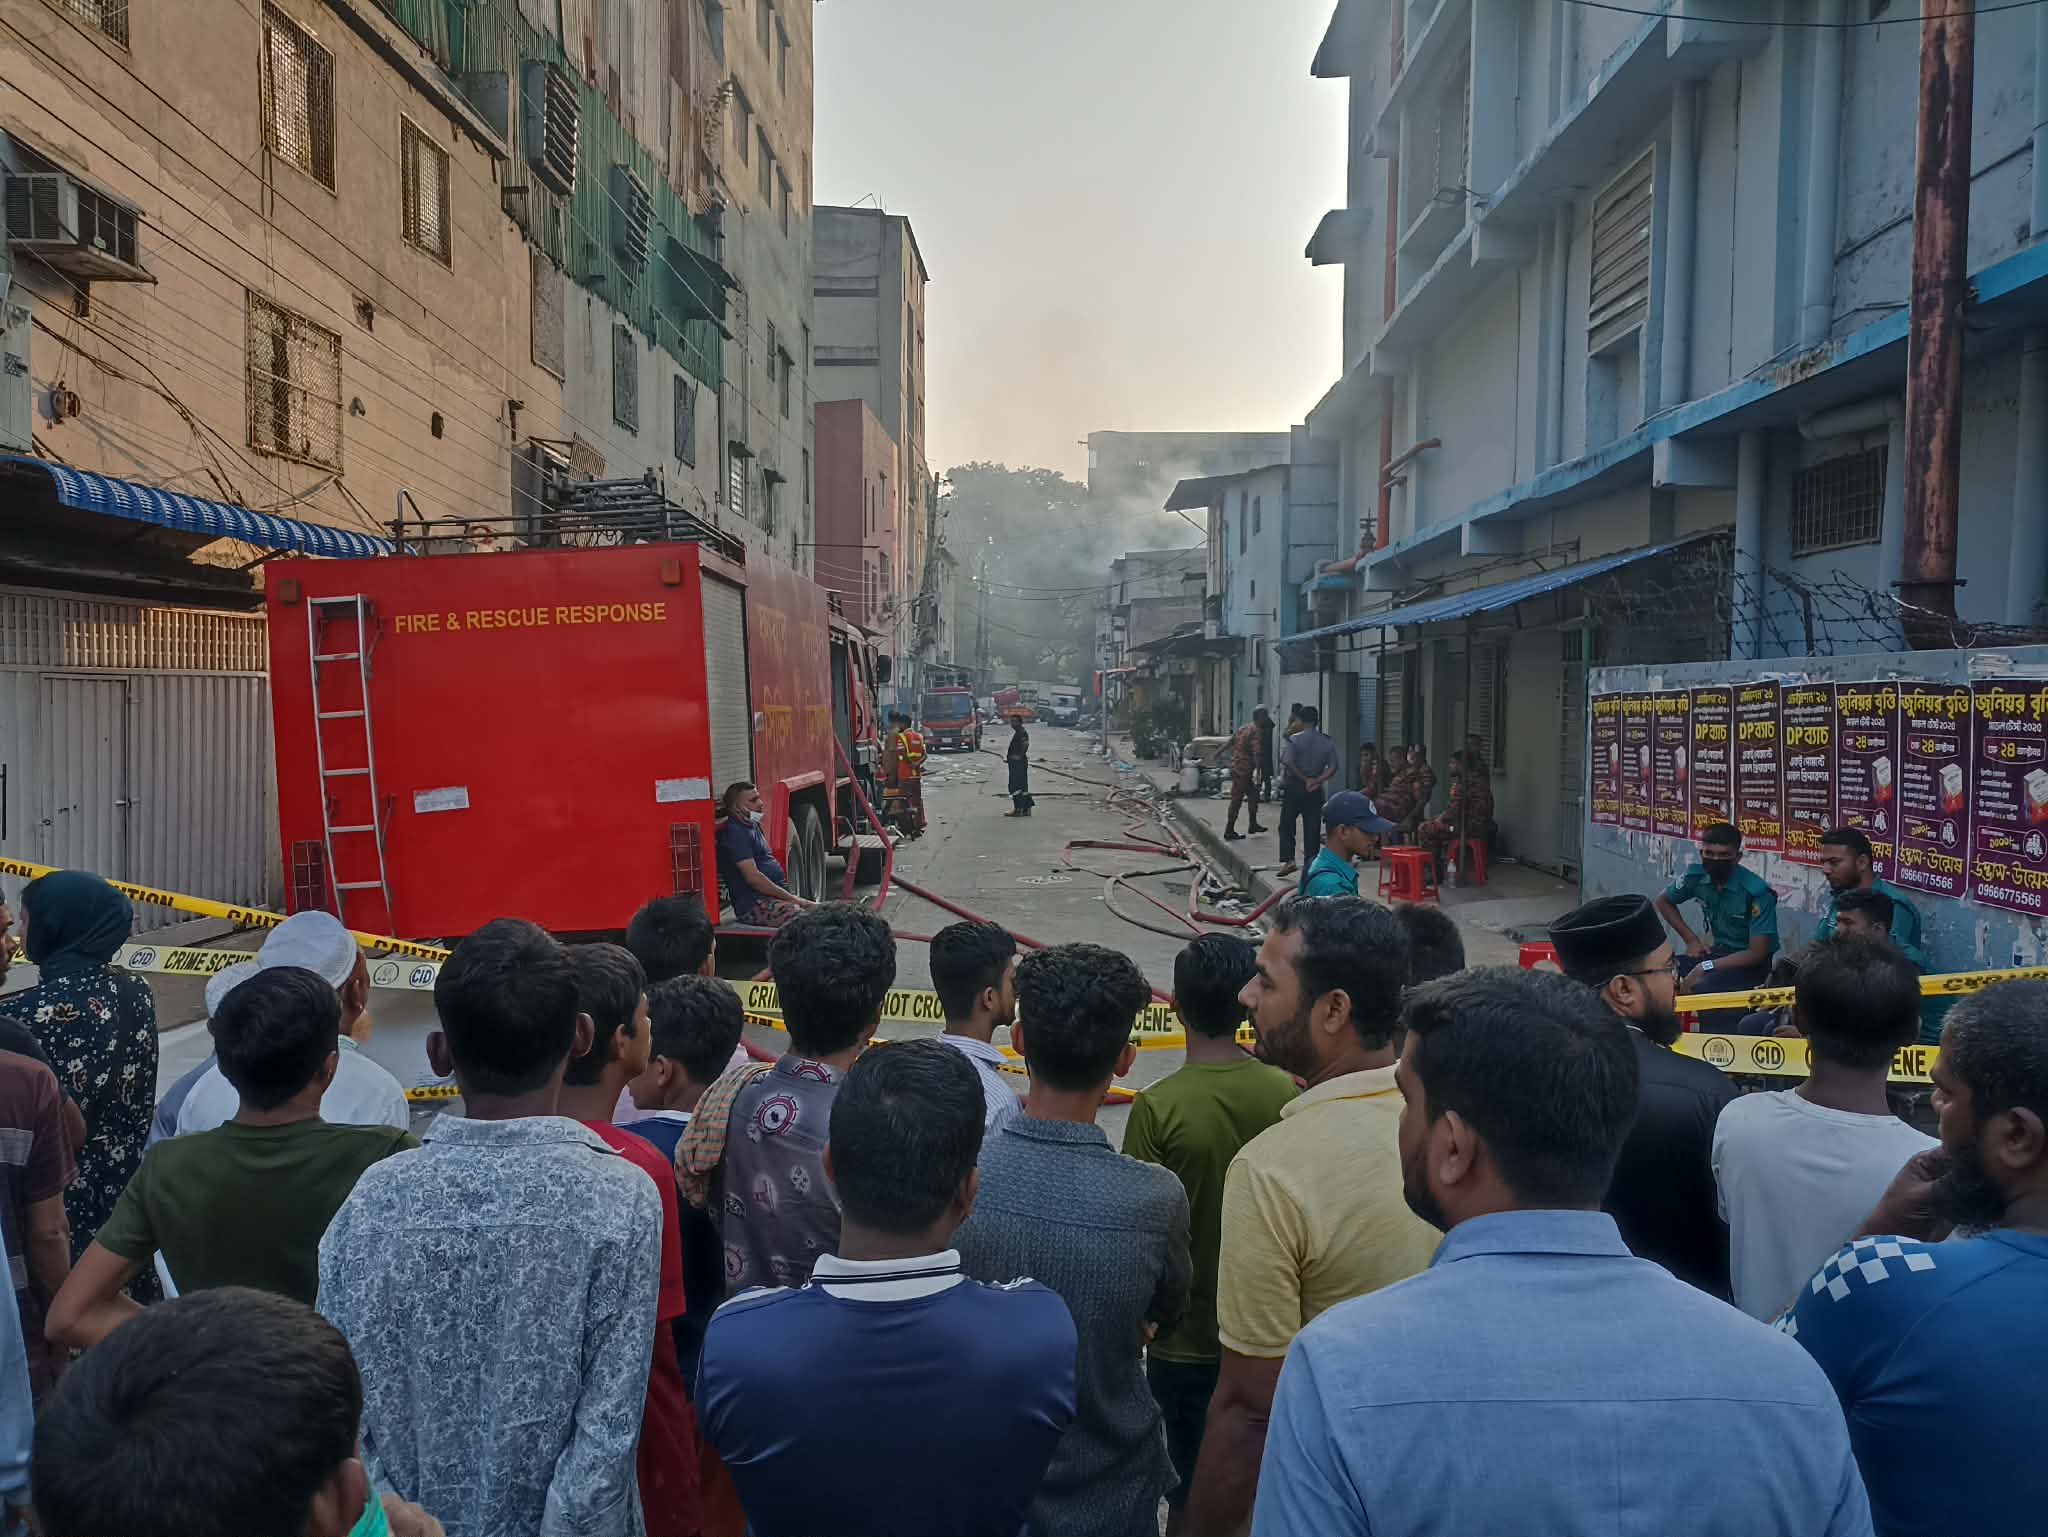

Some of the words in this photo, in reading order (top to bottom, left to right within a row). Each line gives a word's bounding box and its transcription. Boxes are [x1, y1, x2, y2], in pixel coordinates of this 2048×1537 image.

[395, 613, 441, 633] FIRE
[446, 612, 462, 631] &
[467, 607, 550, 630] RESCUE
[556, 602, 667, 626] RESPONSE
[1838, 688, 1873, 716] জুনিয়র
[1874, 688, 1896, 716] বৃত্তি
[1901, 688, 1944, 718] জুনিয়র
[1945, 689, 1969, 719] বৃত্তি
[1975, 686, 2026, 720] জুনিয়র
[1696, 723, 1708, 740] DP
[1739, 722, 1754, 740] DP
[1754, 721, 1775, 738] ব্যাচ
[1786, 727, 1803, 745] DP
[1804, 727, 1830, 745] ব্যাচ
[1855, 735, 1868, 750] ২৪
[1921, 738, 1935, 753] ২৪
[2000, 742, 2016, 758] ২৪
[1900, 866, 1953, 890] 09666775566
[1977, 882, 2042, 908] 09666775566
[131, 950, 153, 966] CID
[163, 951, 203, 971] CRIME
[373, 939, 449, 962] CAUTIO
[411, 968, 432, 984] CID
[913, 994, 946, 1020] CRO
[1133, 1007, 1172, 1032] CENE
[1755, 1045, 1781, 1065] CID
[1891, 1049, 1926, 1076] ENE
